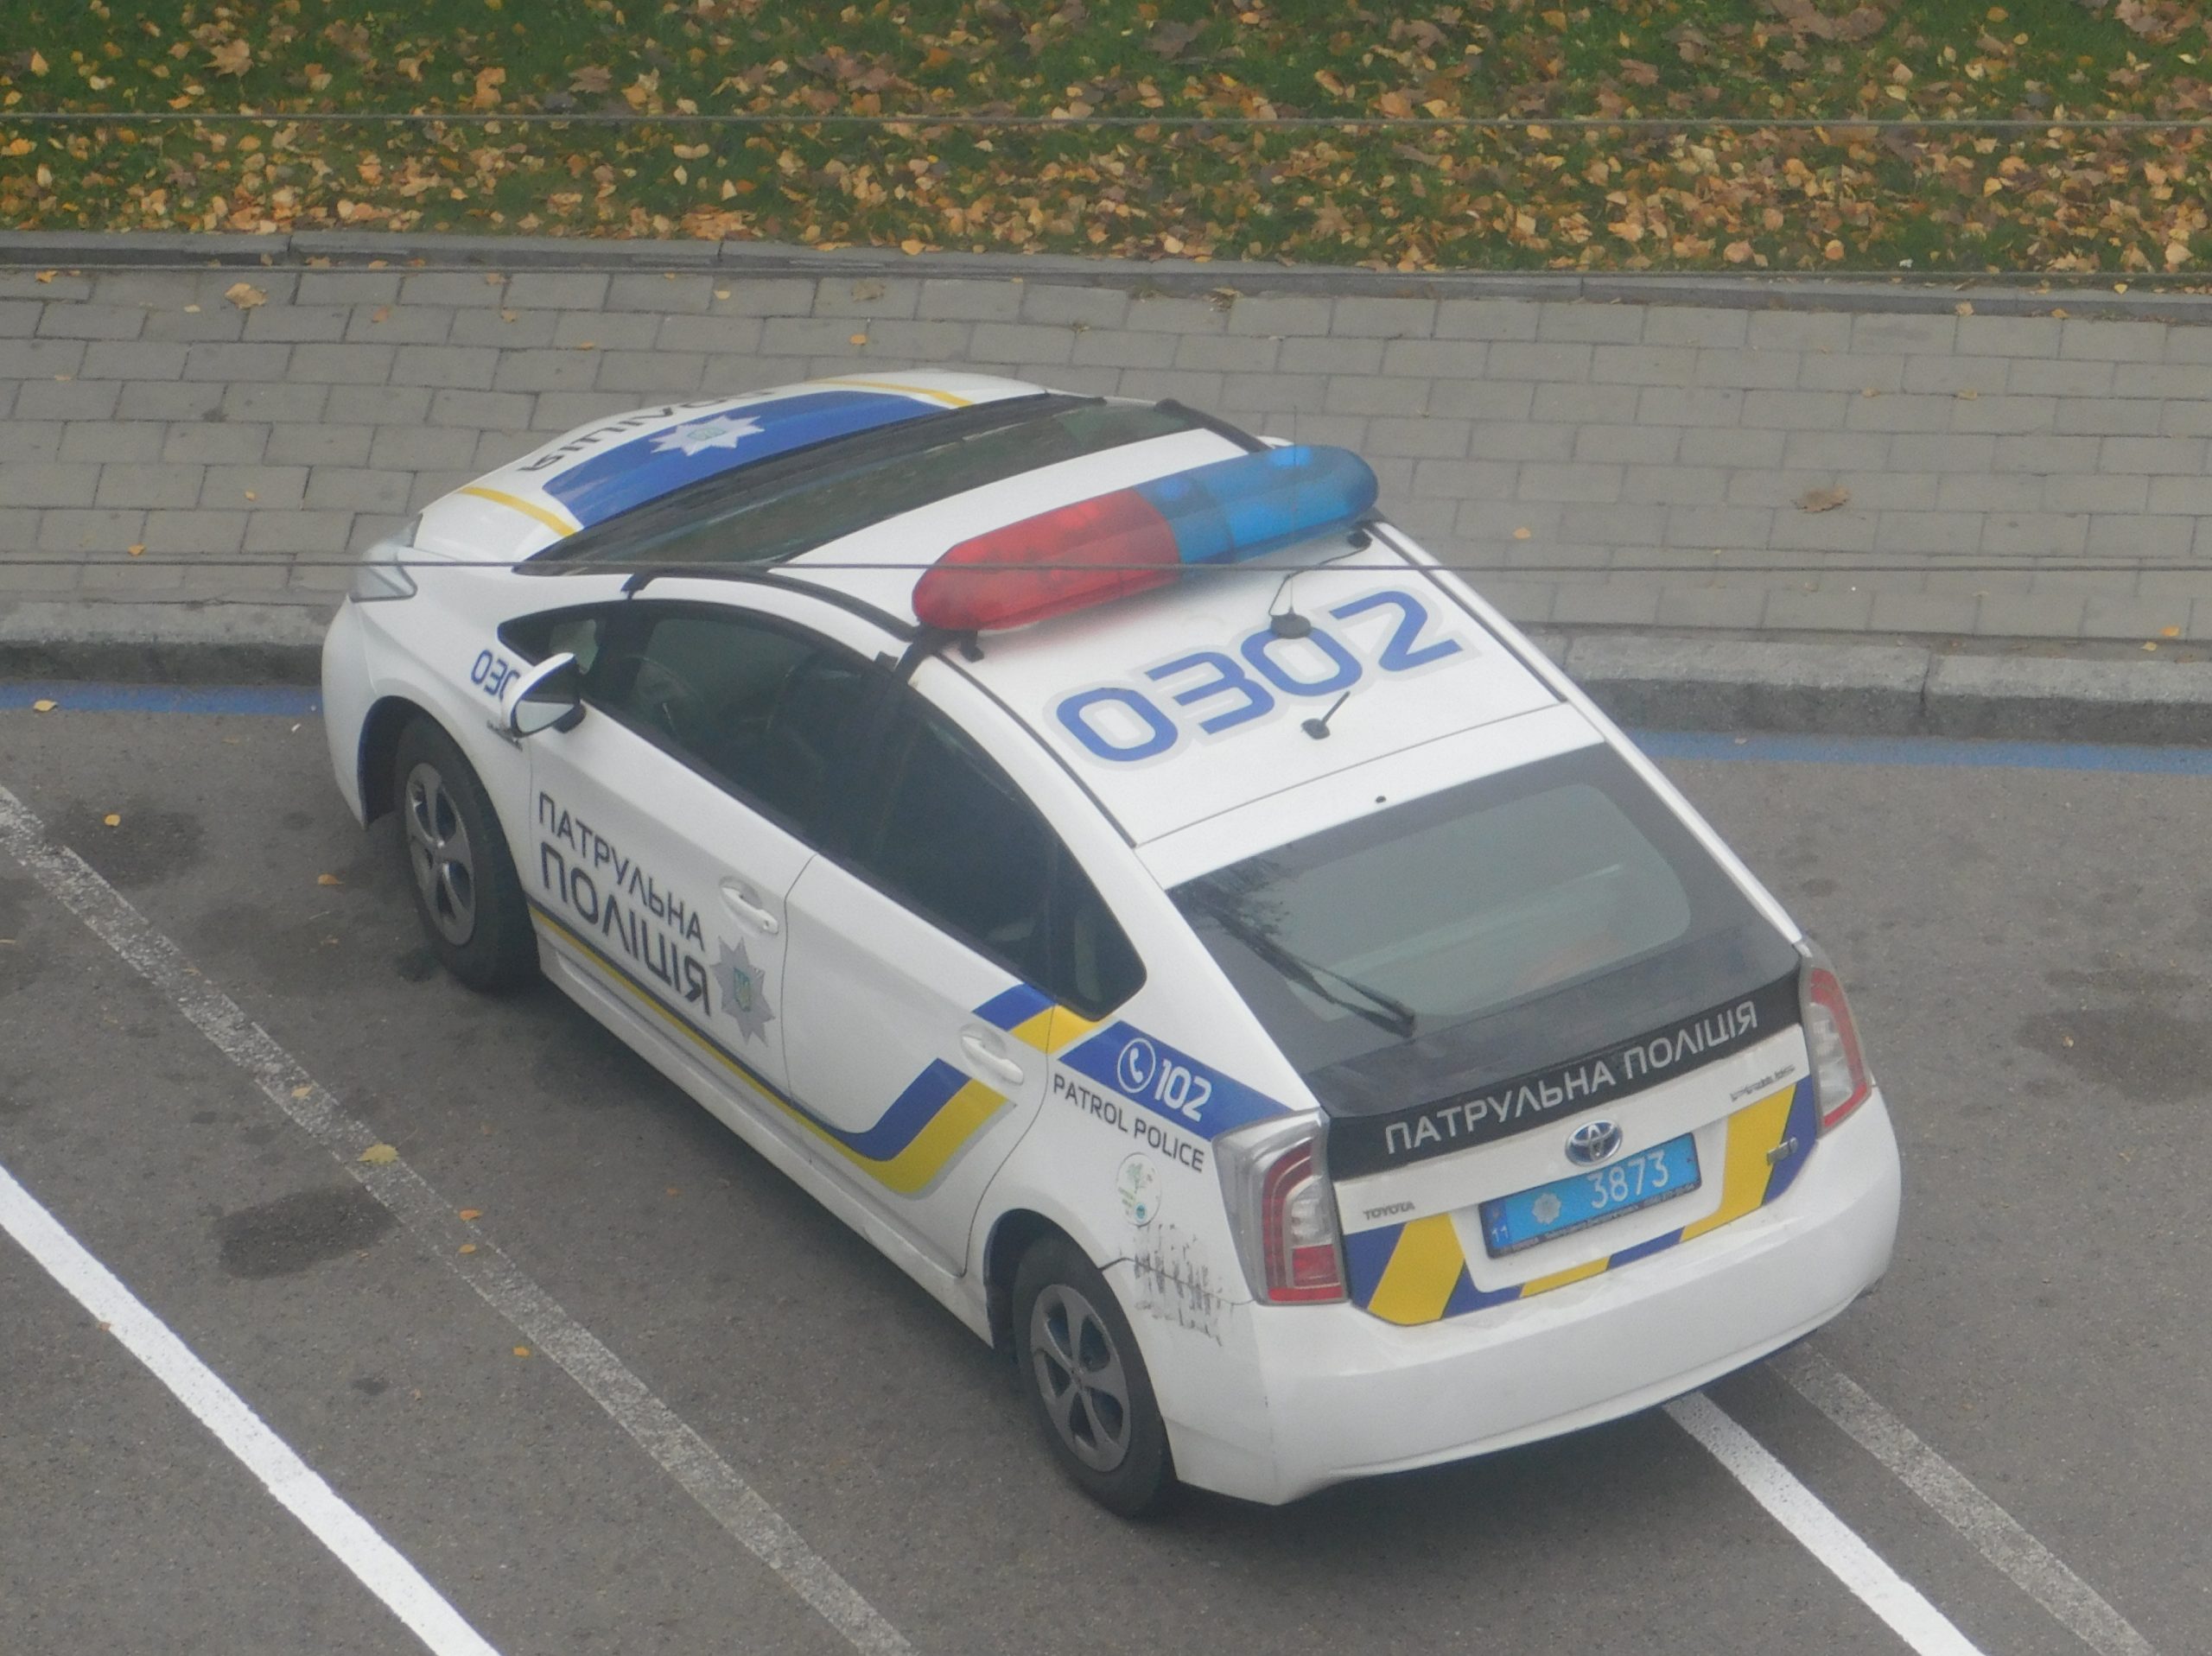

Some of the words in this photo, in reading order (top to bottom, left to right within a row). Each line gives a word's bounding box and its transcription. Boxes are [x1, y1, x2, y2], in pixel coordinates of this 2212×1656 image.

[1056, 590, 1464, 762] 0302
[539, 790, 706, 952] ПАТРУЛЬНА
[541, 841, 712, 1018] ПОЛІЦІЯ
[1053, 1074, 1128, 1133] PATROL
[1135, 1119, 1205, 1173] POLICE
[1154, 1058, 1212, 1122] 102
[1385, 1058, 1618, 1155] ПАТРУЛЬНА
[1624, 1000, 1758, 1080] ПОЛІЦІЯ
[1363, 1201, 1415, 1221] TOYOTA
[1586, 1149, 1669, 1209] 3873
[1491, 1225, 1508, 1242] 11
